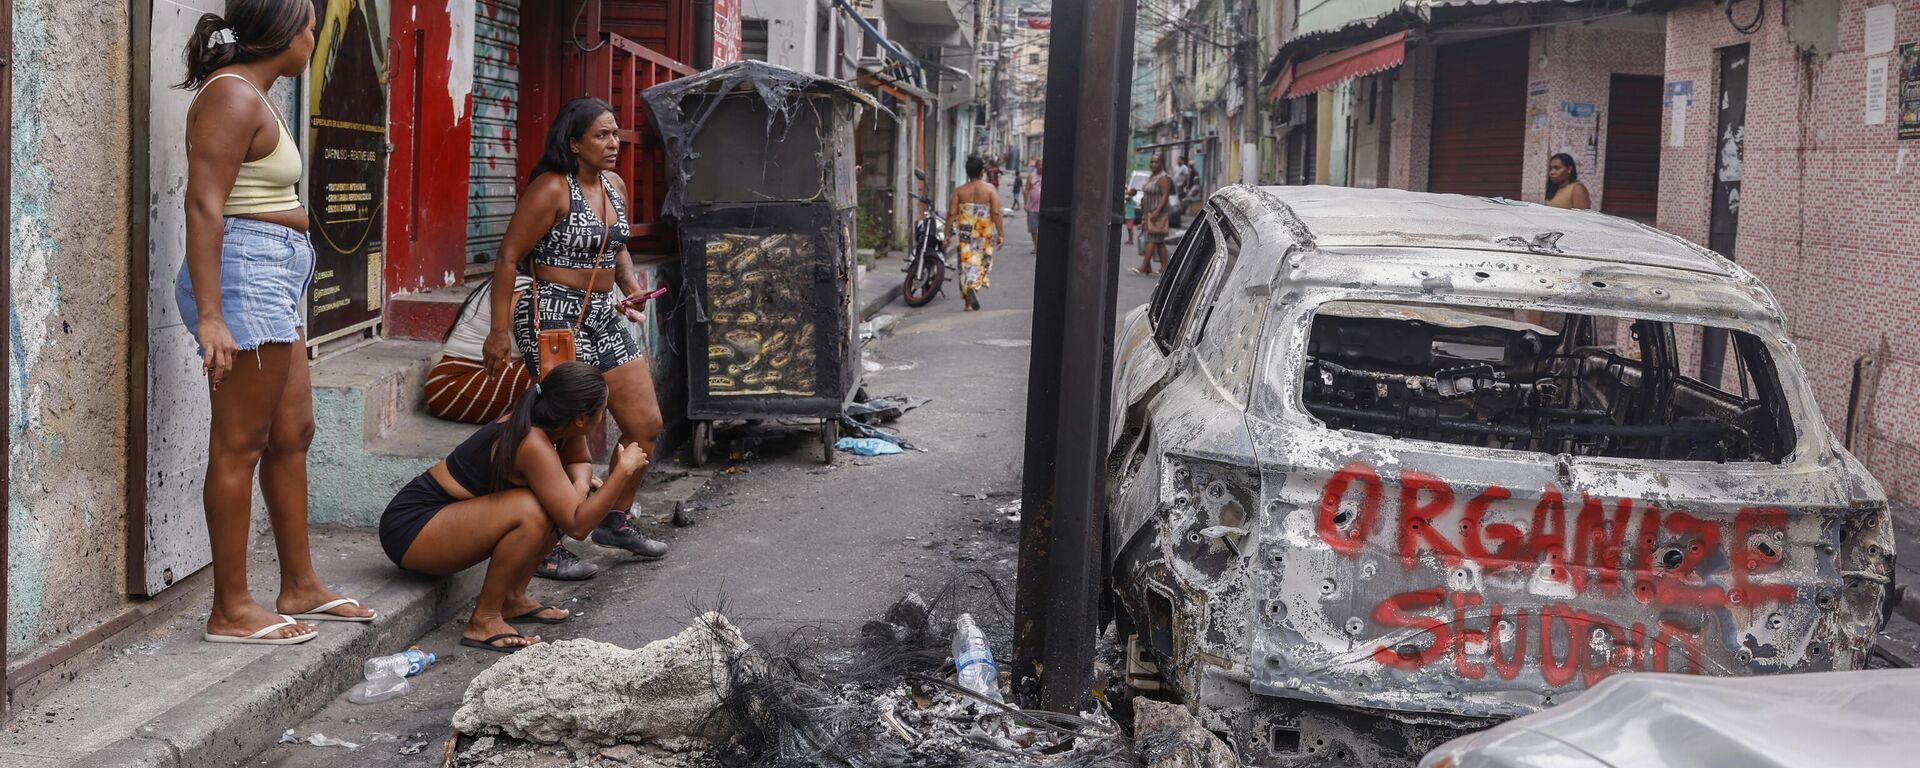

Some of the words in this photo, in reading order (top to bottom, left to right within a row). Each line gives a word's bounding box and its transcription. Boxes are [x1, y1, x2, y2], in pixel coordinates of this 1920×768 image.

[566, 226, 593, 236] LIVES
[546, 298, 582, 316] LIVES
[538, 312, 564, 320] LIVES
[1314, 462, 1798, 608] ORGANIZE
